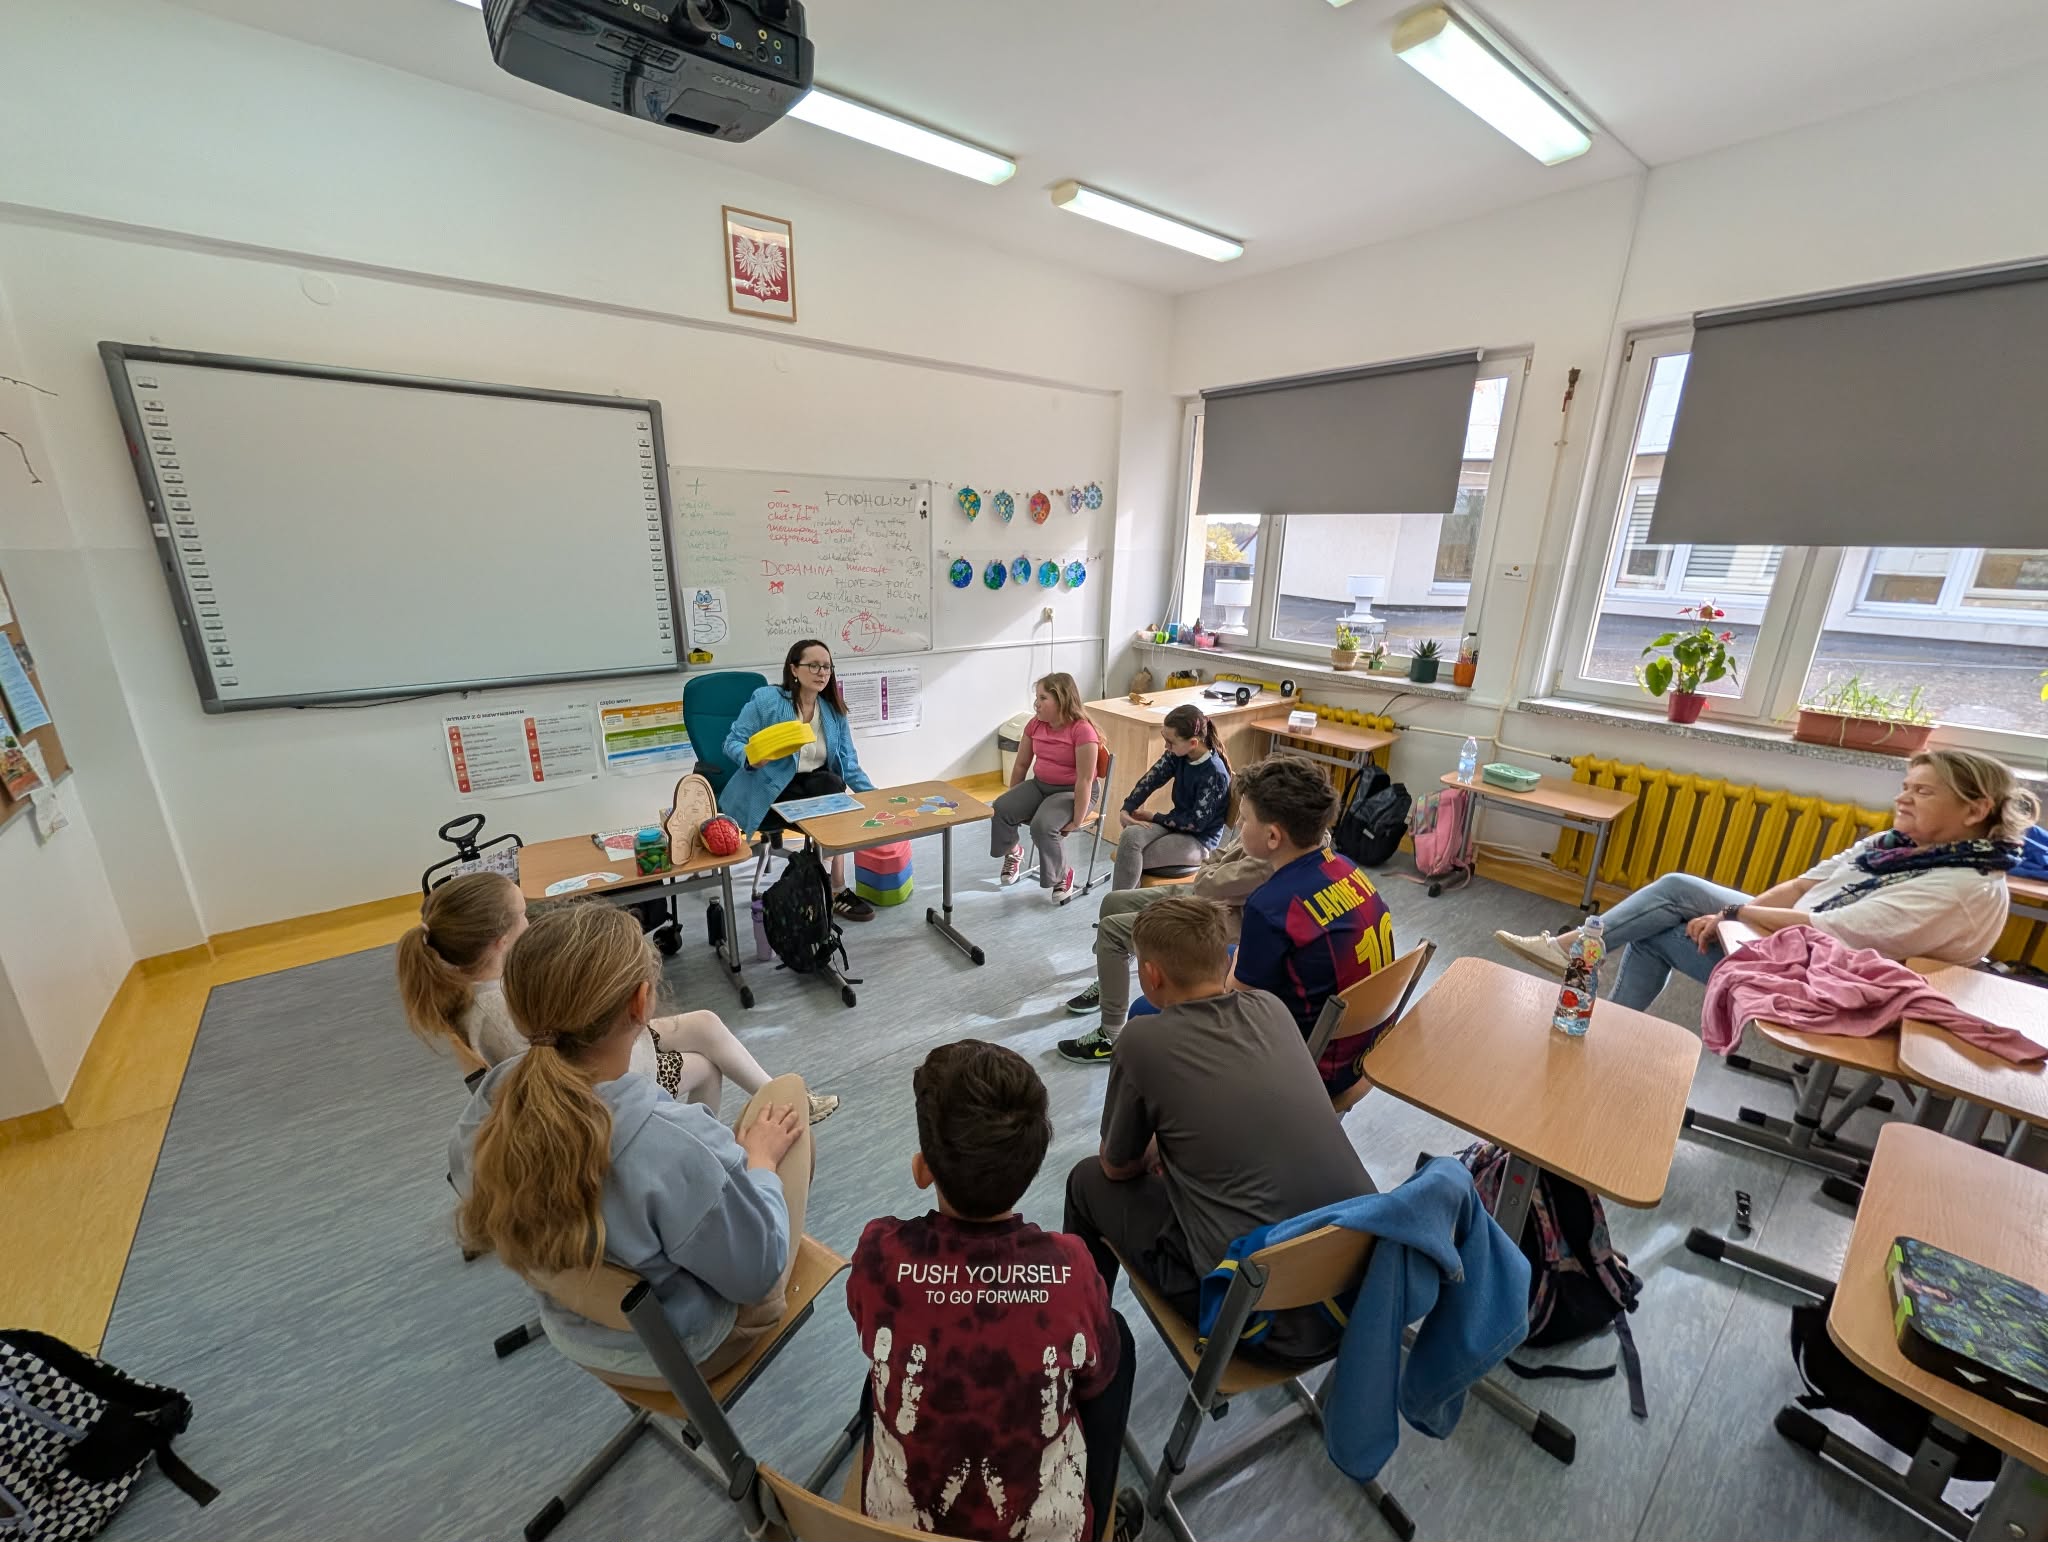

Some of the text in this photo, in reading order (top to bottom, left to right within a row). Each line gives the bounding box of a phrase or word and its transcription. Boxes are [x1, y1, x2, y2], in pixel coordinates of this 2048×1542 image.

[1303, 877, 1366, 927] LAMINE
[1354, 911, 1396, 976] 10
[897, 1263, 1072, 1285] PUSH YOURSELF
[925, 1290, 1050, 1304] TO GO FORWARD
